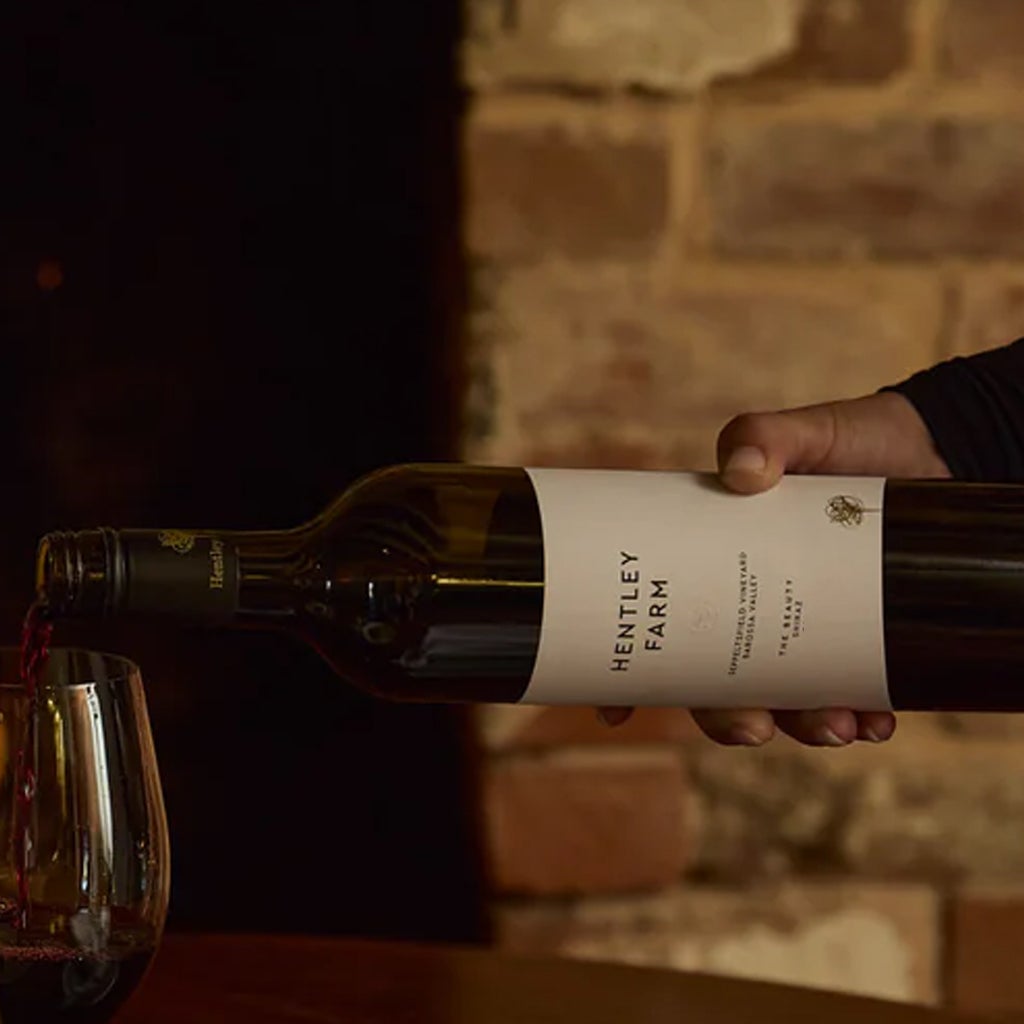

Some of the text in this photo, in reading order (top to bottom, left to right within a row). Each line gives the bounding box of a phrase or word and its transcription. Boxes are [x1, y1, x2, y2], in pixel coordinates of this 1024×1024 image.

[209, 540, 224, 588] Hentley
[610, 551, 639, 671] HENTLEY
[644, 579, 668, 650] FARM
[728, 552, 748, 675] SEPPELTSFIELD VINEYARD
[742, 574, 758, 659] BAROSSA VALLEY
[778, 579, 793, 656] THE BEAUTY
[792, 601, 803, 637] SHIRAZ
